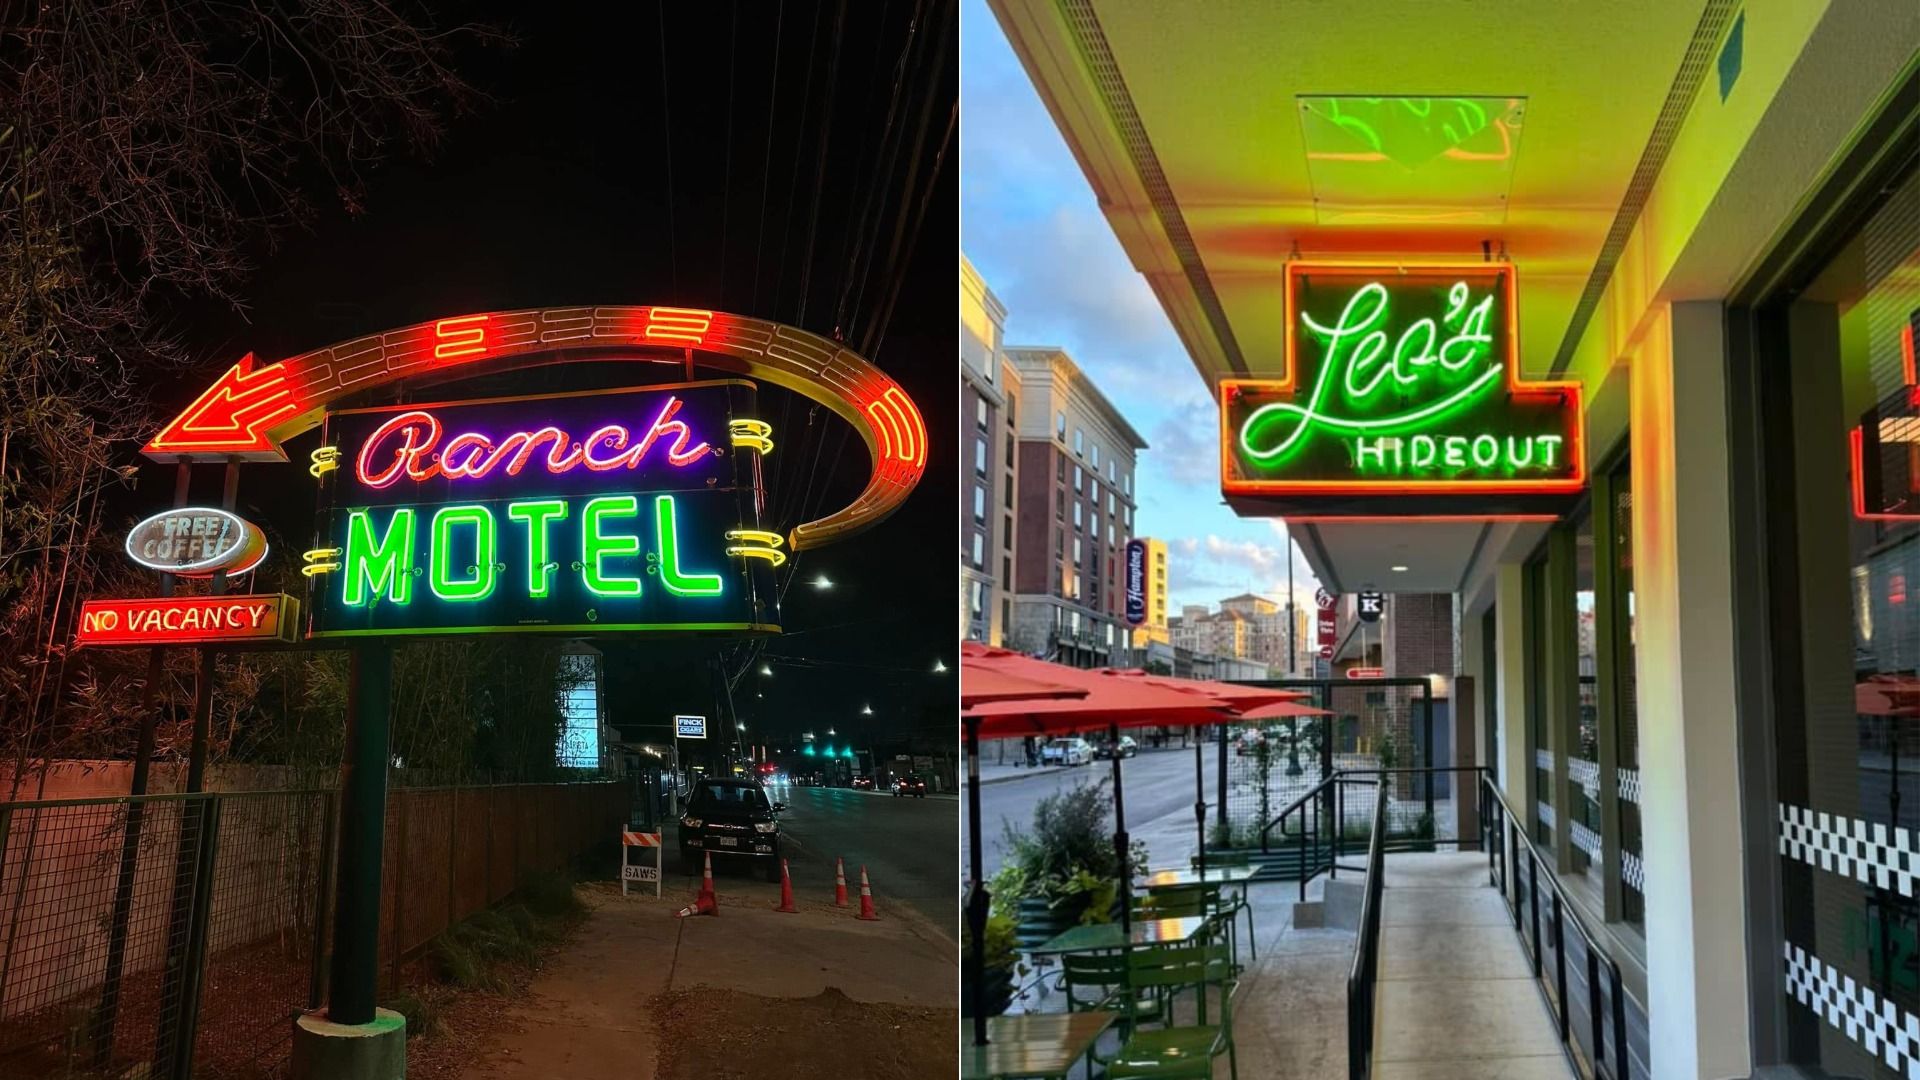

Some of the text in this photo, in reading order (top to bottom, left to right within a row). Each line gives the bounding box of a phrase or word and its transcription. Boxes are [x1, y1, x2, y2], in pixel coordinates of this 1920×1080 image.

[355, 396, 722, 489] Ranch
[1356, 434, 1562, 467] HIDEOUT
[143, 538, 231, 560] COFFEE
[342, 494, 723, 606] MOTEL
[1127, 545, 1145, 610] Hampton
[84, 604, 273, 633] NO VACANCY
[625, 867, 657, 879] SAWS
